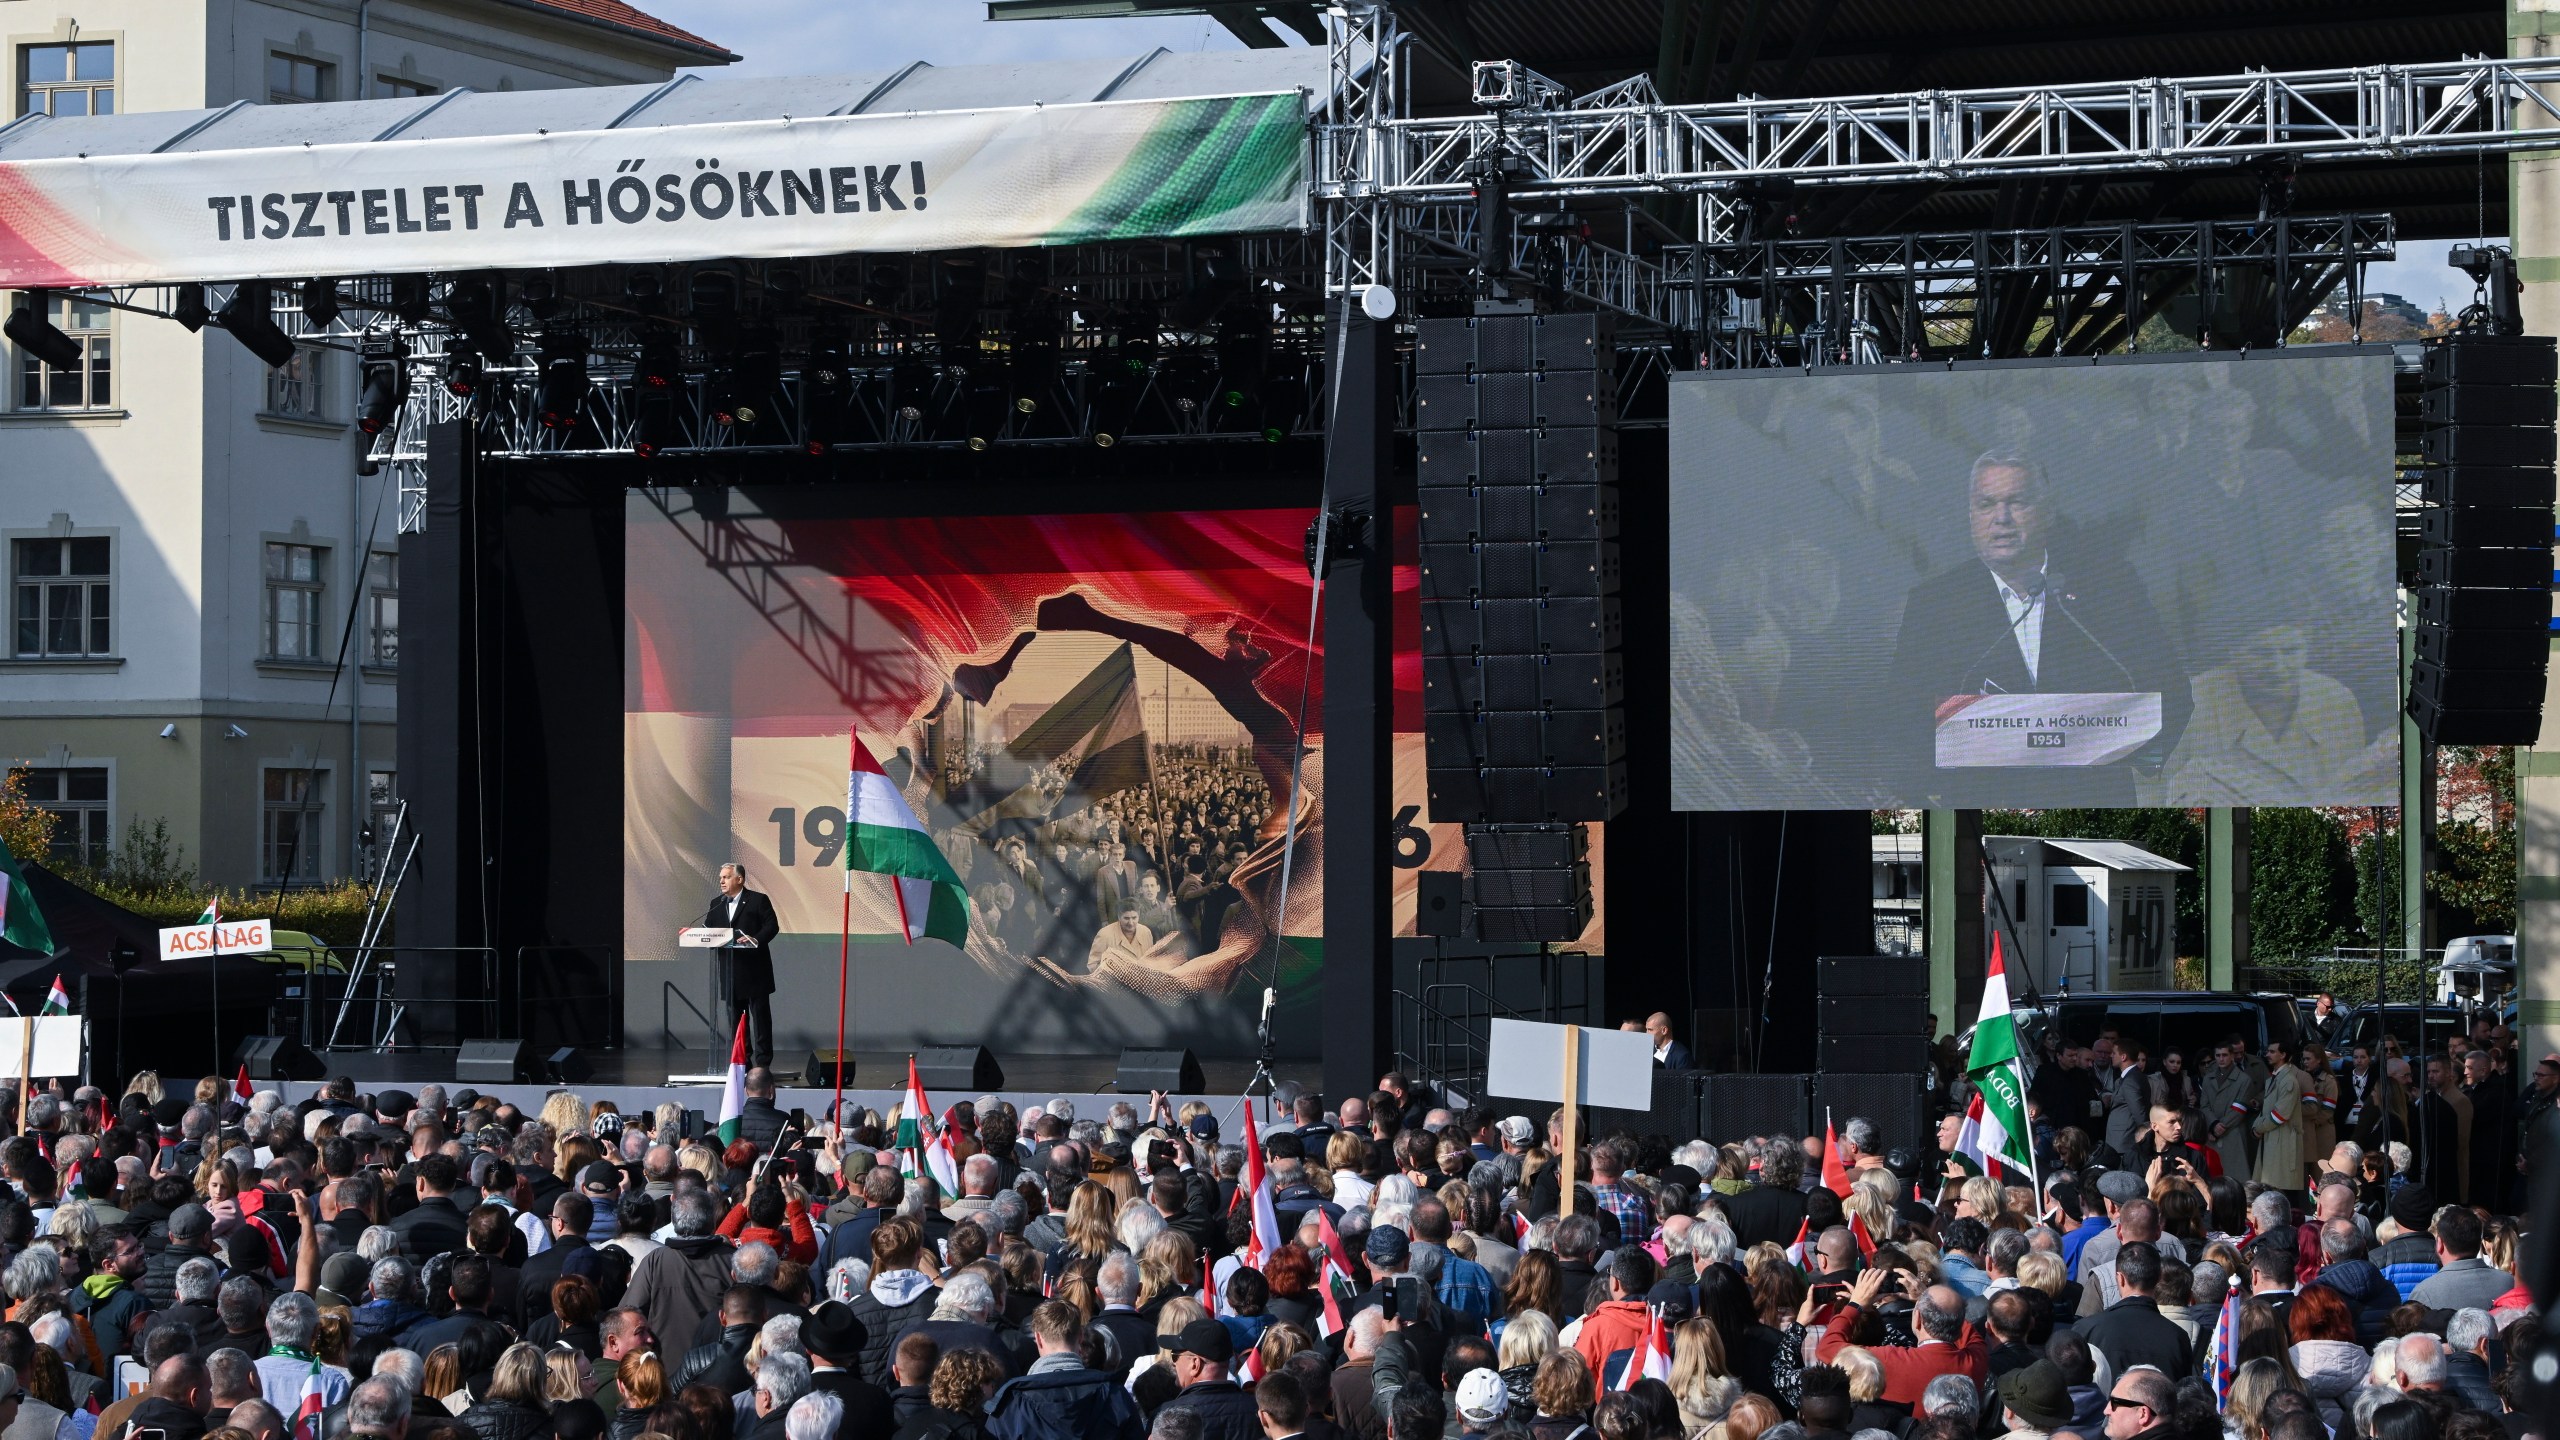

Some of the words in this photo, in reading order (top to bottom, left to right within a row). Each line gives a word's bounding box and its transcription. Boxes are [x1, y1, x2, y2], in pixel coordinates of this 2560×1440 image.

[208, 184, 484, 240] TISZTELET
[503, 182, 544, 229] A
[562, 158, 928, 226] HŐSÖKNEK!
[1968, 717, 2030, 728] TISZTELET
[2036, 717, 2044, 727] A
[2050, 713, 2127, 728] HŐSÖKNEK!
[2033, 735, 2060, 745] 1956
[768, 805, 847, 867] 19
[1393, 805, 1431, 869] 6
[170, 926, 262, 952] ACSALAG
[2119, 886, 2165, 970] HD
